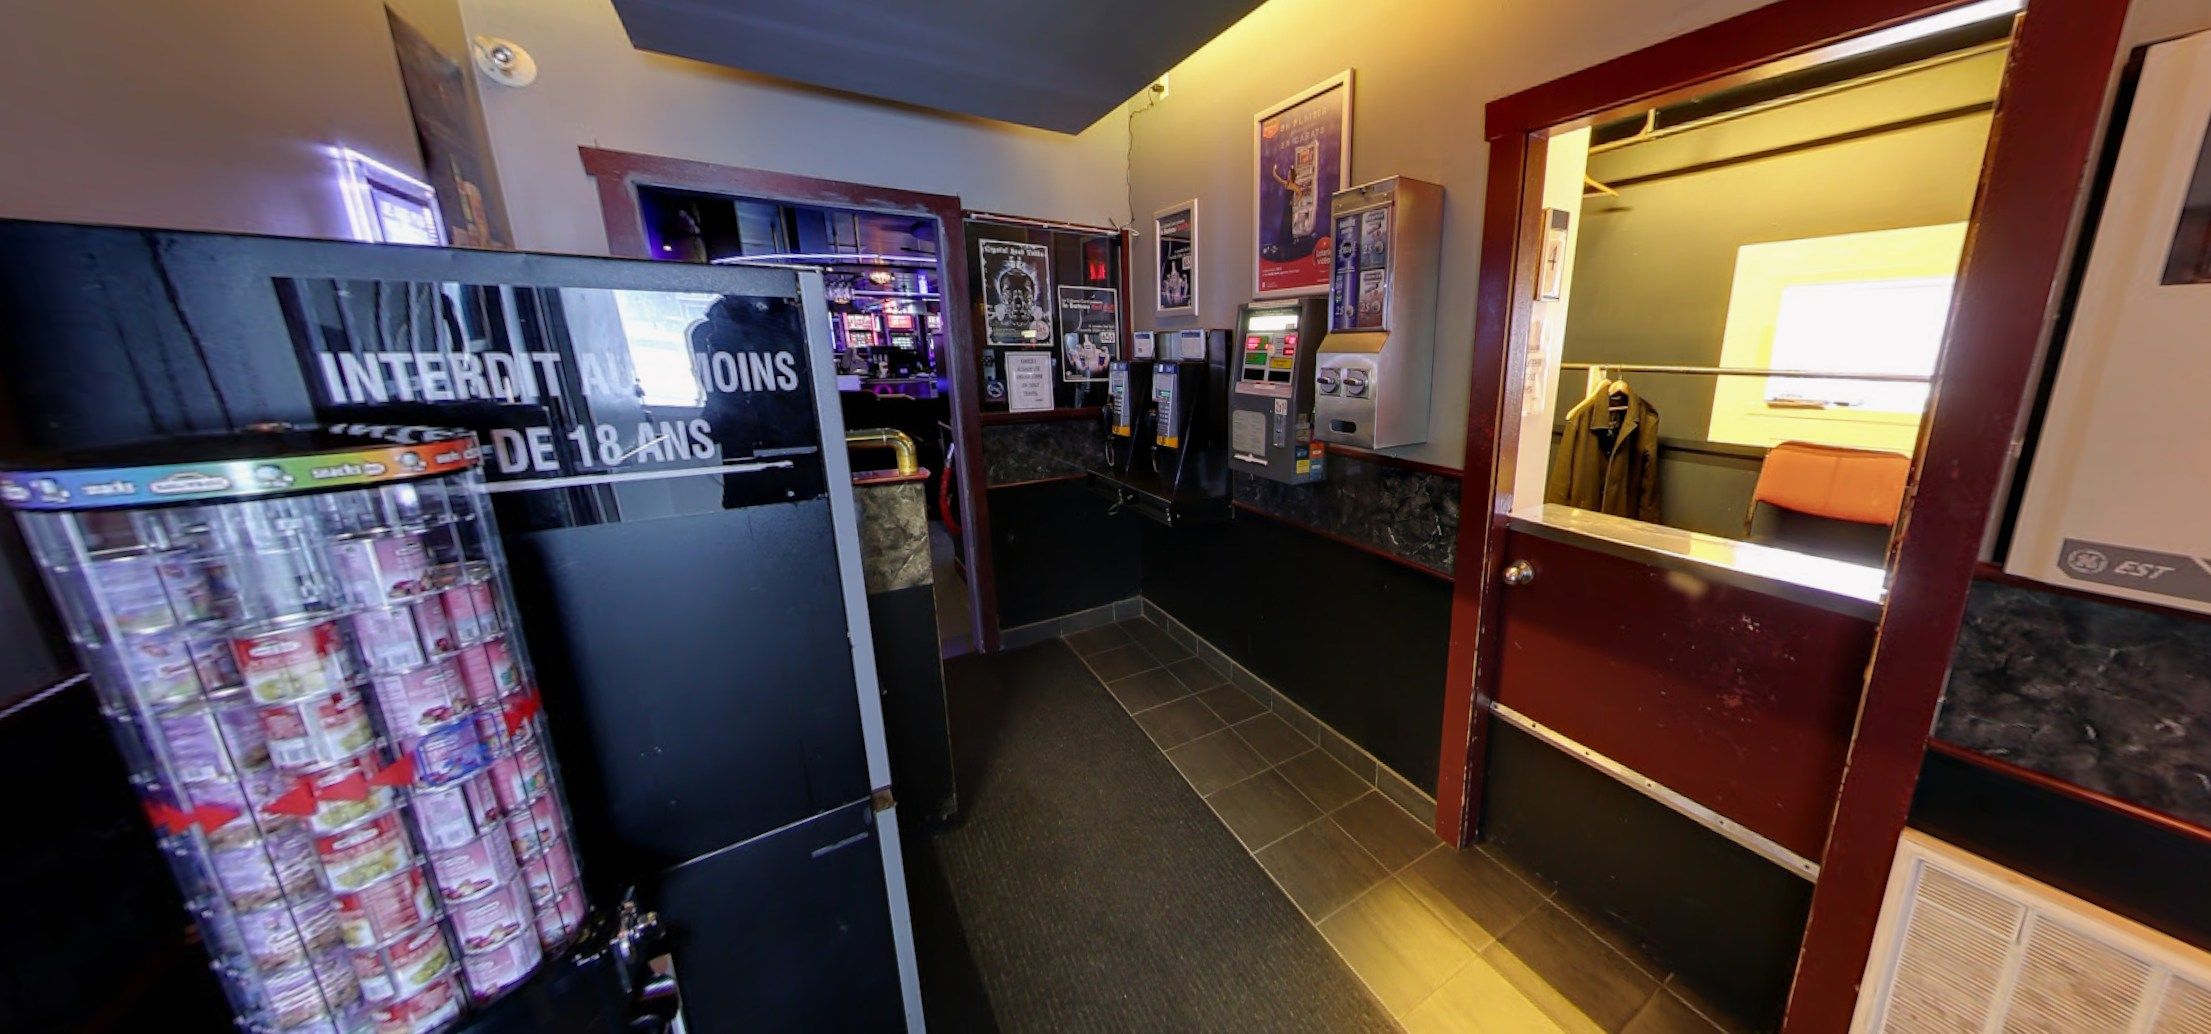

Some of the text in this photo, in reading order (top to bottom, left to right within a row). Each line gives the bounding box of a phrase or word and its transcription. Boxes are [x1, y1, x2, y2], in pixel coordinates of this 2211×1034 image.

[318, 351, 562, 405] INTERDIT
[581, 352, 645, 396] AU
[490, 418, 716, 474] DE 18 ANS
[2113, 560, 2175, 579] EST
